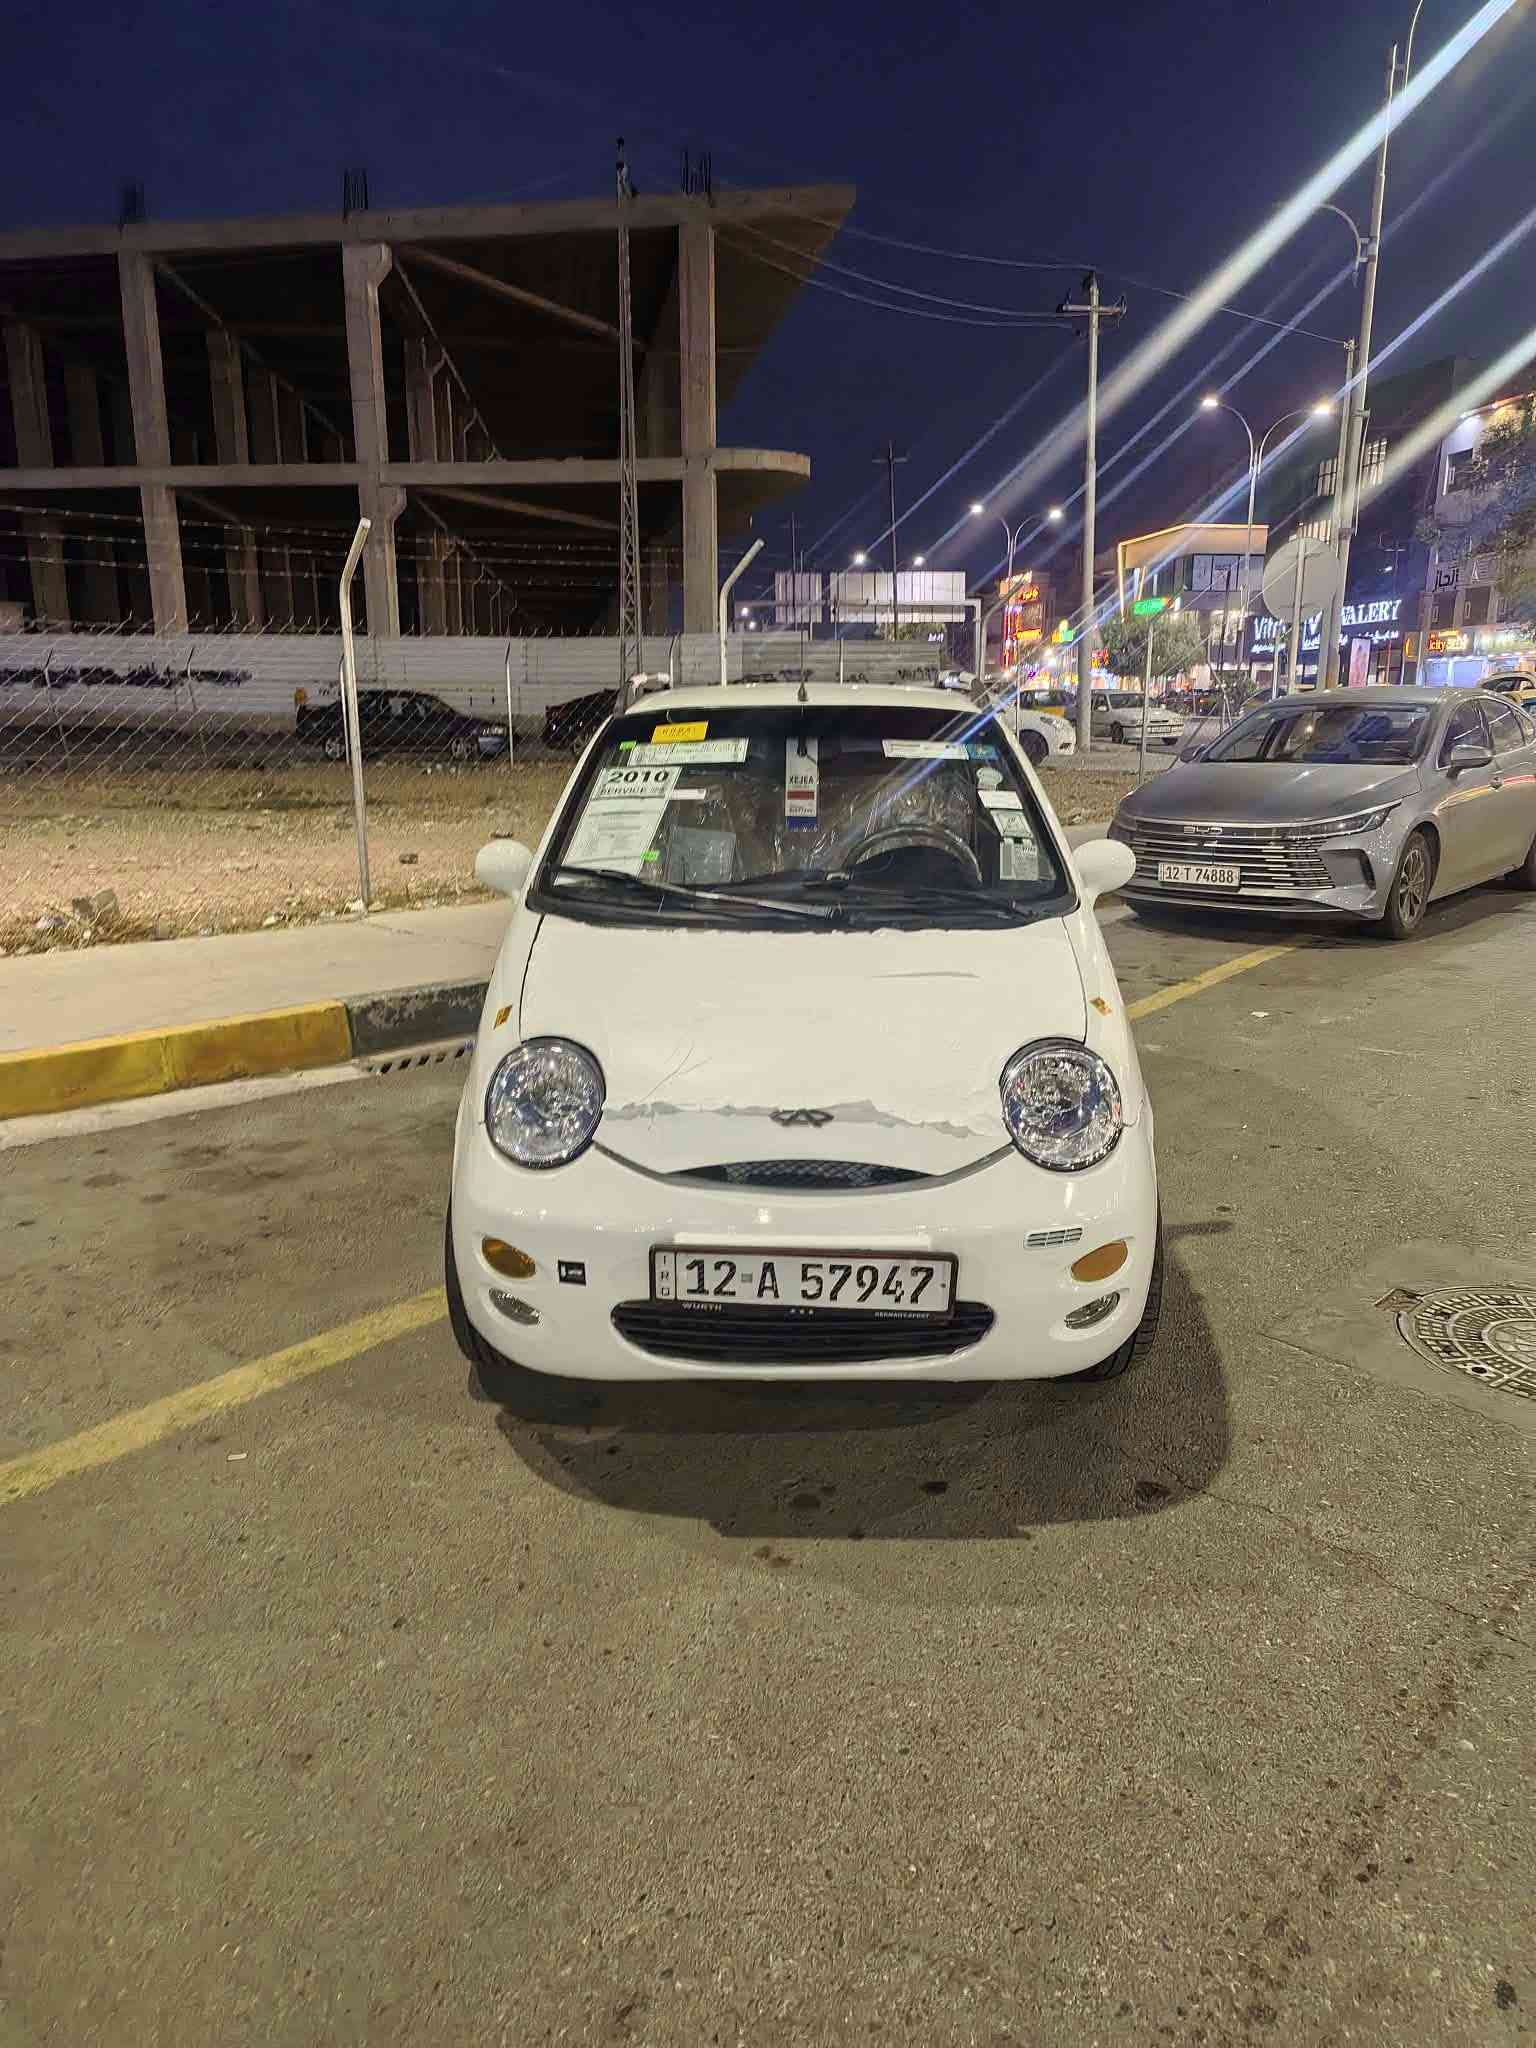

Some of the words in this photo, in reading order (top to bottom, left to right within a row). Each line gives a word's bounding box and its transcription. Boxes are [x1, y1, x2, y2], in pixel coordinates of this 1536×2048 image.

[607, 770, 669, 783] 2010
[1166, 866, 1181, 880] 12
[800, 1263, 935, 1304] 57947
